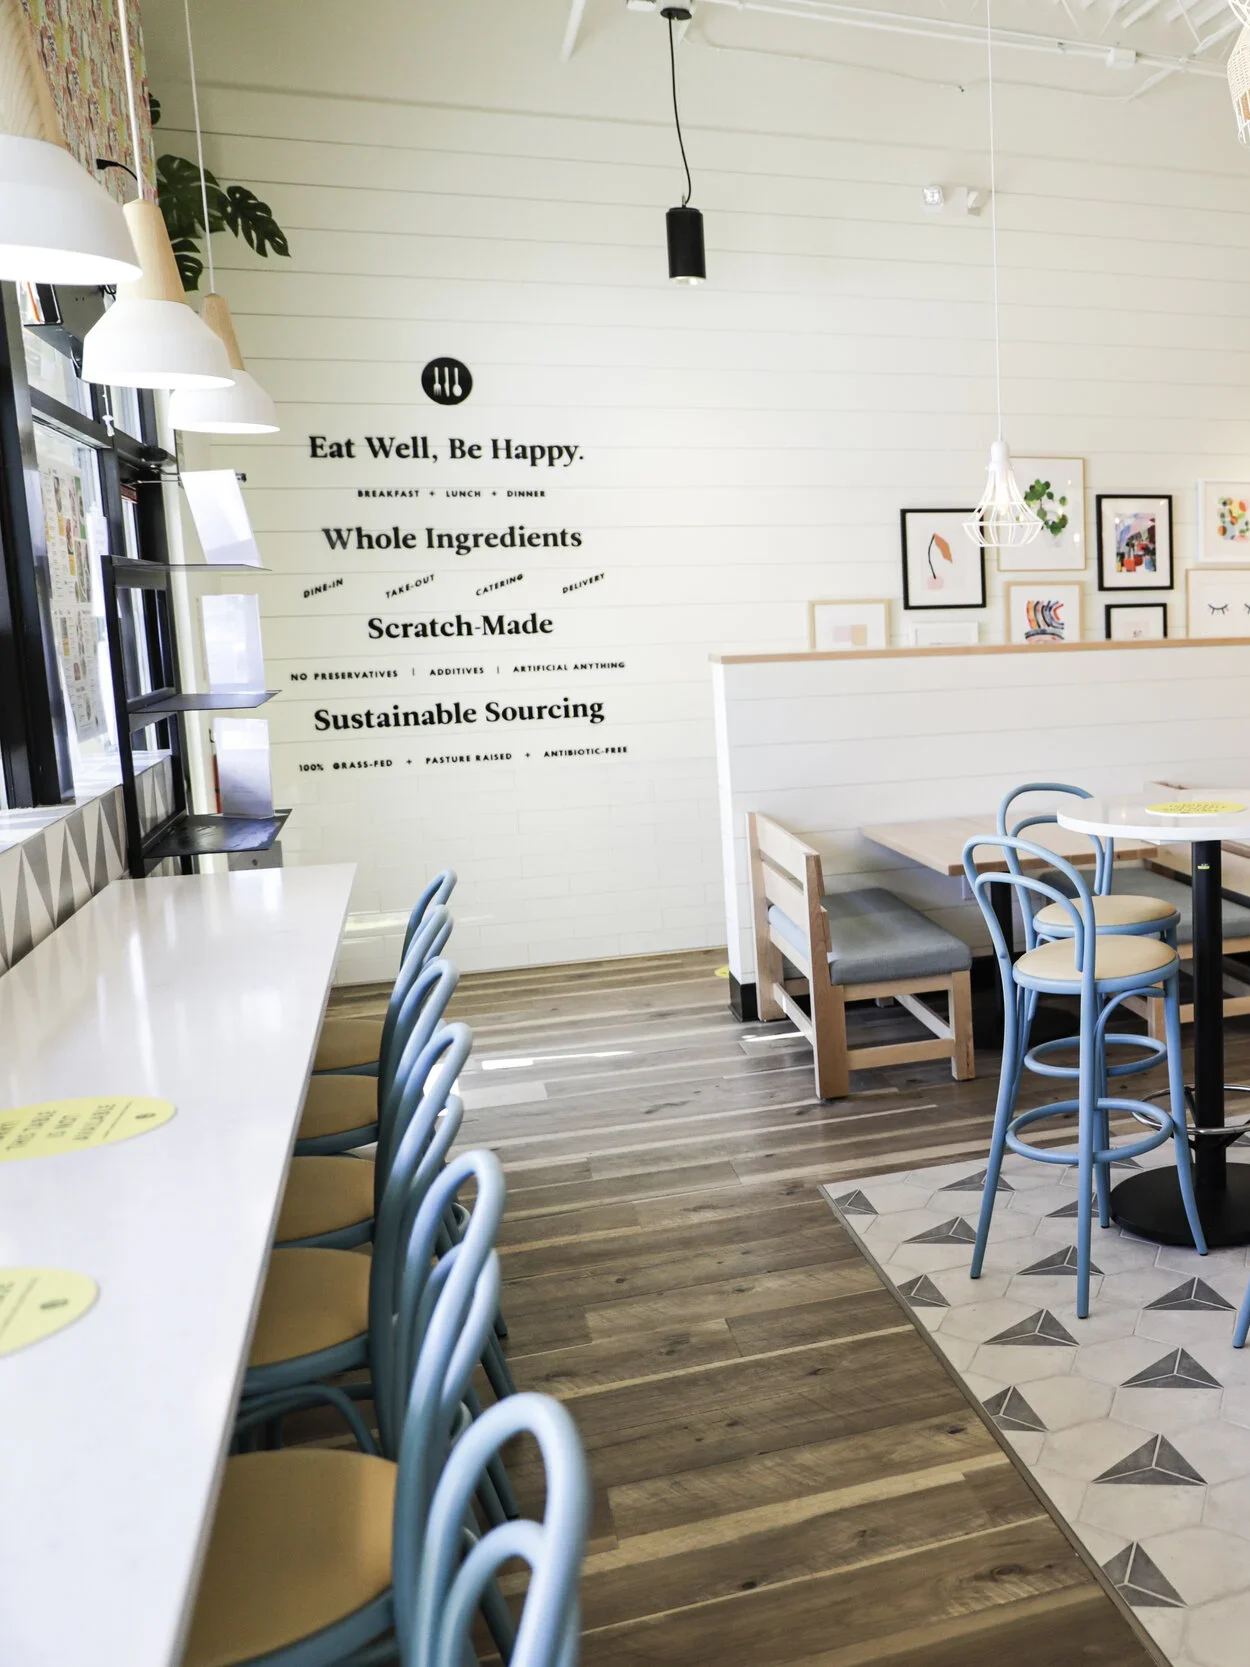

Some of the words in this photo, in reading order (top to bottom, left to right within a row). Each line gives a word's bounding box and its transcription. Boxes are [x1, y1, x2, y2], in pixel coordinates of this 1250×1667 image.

[308, 435, 356, 459] Eat
[364, 435, 438, 463] Well,
[448, 437, 482, 460] Be
[490, 438, 584, 468] Happy.
[357, 489, 419, 498] BREAKFAST
[445, 490, 481, 498] LUNCH
[506, 490, 545, 498] DINNER
[321, 526, 417, 550] Whole
[425, 525, 583, 556] Ingredients
[303, 578, 344, 599] DINE-IN
[385, 574, 434, 599] TAKE-OUT
[475, 573, 524, 597] CATERING
[562, 572, 605, 594] DELIVERY
[367, 612, 553, 640] Scratch-Made
[290, 672, 308, 681] NO
[313, 670, 398, 681] PRESERVATIVES
[429, 667, 484, 676] ADDITIVES
[513, 664, 568, 673] ARTIFICIAL
[573, 661, 625, 670] ANYTHING
[313, 701, 477, 732] Sustainable
[484, 696, 605, 725] Sourcing
[299, 763, 324, 772] 100%
[332, 759, 393, 770] GRASS-FED
[425, 755, 471, 765] PASTURE
[475, 752, 512, 762] RAISED
[543, 746, 627, 758] ANTIBIOTIC-FREE
